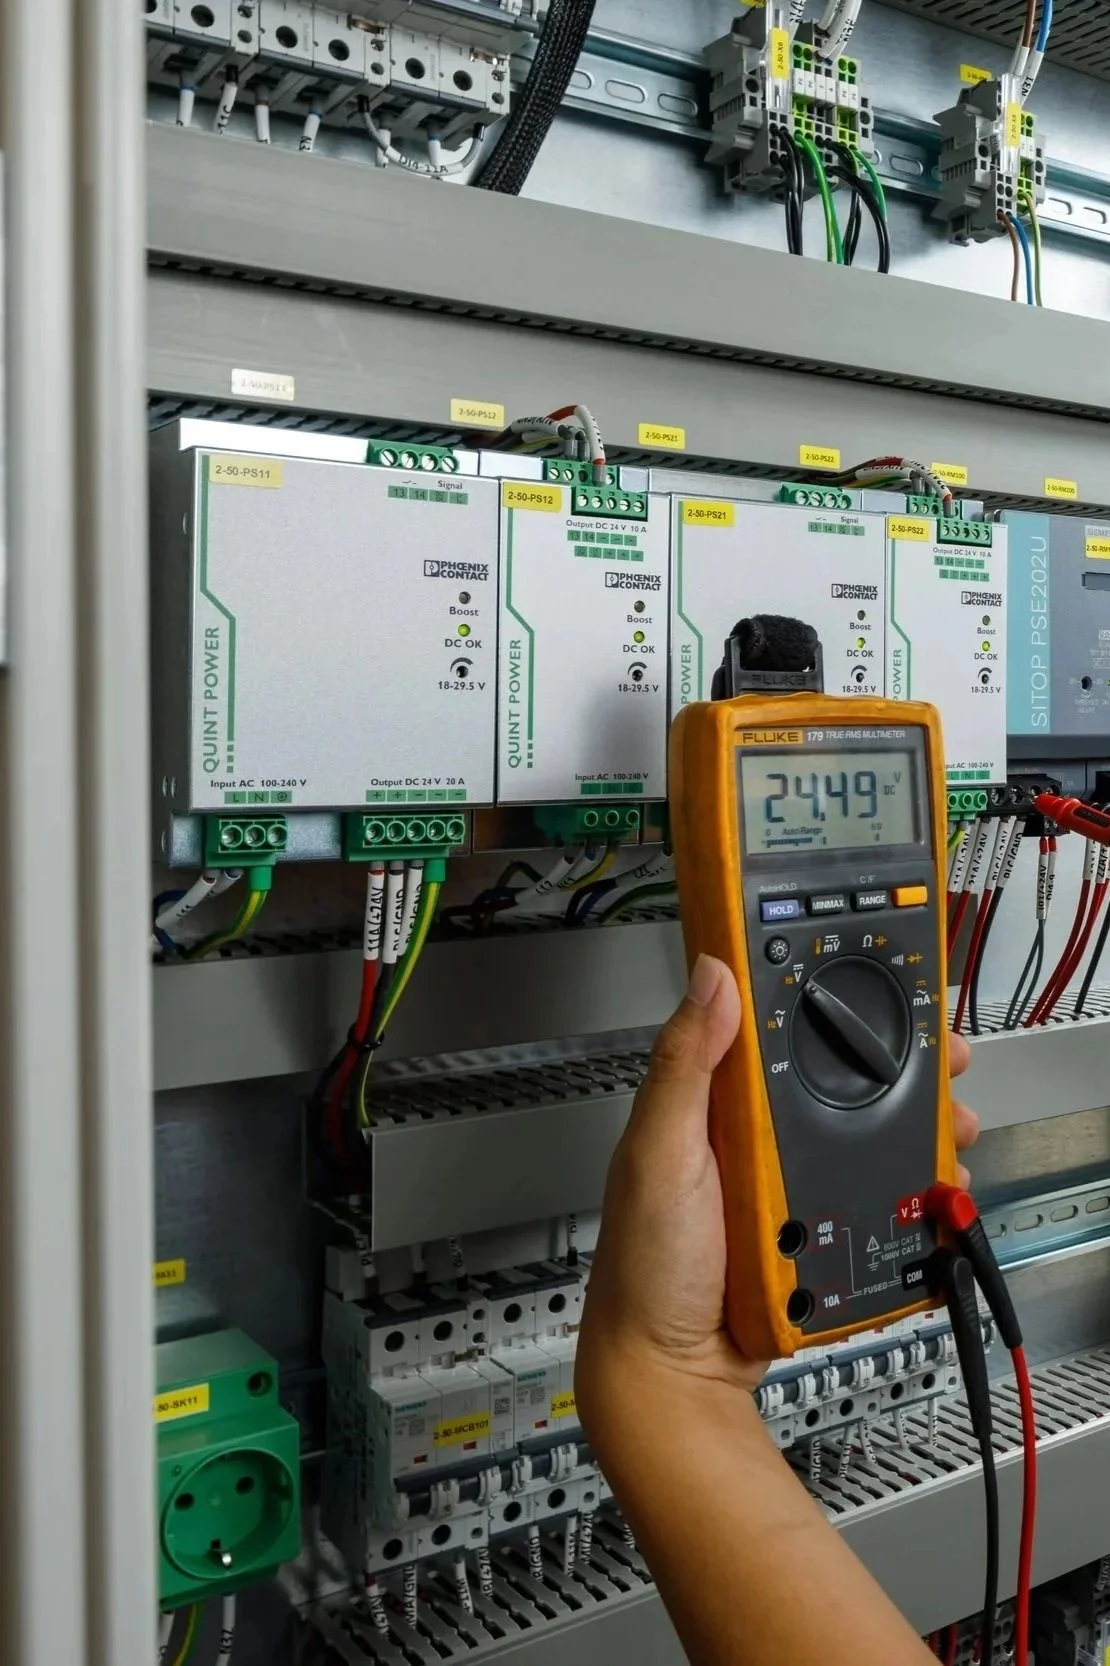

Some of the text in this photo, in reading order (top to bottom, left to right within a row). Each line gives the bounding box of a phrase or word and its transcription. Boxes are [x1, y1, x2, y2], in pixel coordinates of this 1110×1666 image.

[458, 407, 497, 420] 2-50-PS12
[645, 430, 678, 442] 2-50-PS21
[805, 453, 835, 464] 2-50-PS22
[215, 464, 271, 480] 2-50-PS11
[437, 480, 463, 491] Signal
[1047, 484, 1075, 494] 2-50-RM200
[393, 488, 405, 498] 13
[413, 489, 426, 500] 14
[507, 490, 554, 505] 2-50-PS12
[688, 508, 727, 521] 2-50-PS21
[566, 519, 594, 529] Output
[596, 522, 608, 530] DC
[841, 516, 859, 525] Signal
[891, 524, 924, 535] 2-50-PS22
[440, 570, 489, 581] CONTACT
[620, 581, 661, 591] CONTACT
[842, 592, 878, 600] CONTACT
[972, 599, 1002, 607] CONTACT
[449, 606, 479, 617] Boost
[627, 615, 653, 624] Boost
[850, 622, 872, 631] Boost
[1031, 536, 1047, 727] SITOP PSE202U
[444, 638, 482, 649] DC OK
[622, 645, 655, 654] DC OK
[847, 650, 874, 658] DC OK
[974, 652, 998, 661] DC OK
[681, 644, 692, 704] POWER
[439, 681, 486, 691] 18-29.5 V
[751, 674, 807, 687] FLUKE
[618, 684, 659, 693] 18-29.5 V
[842, 685, 877, 694] 18-29.5 V
[203, 626, 220, 773] QUINT POWER
[508, 639, 521, 769] QUINT POWER
[742, 731, 799, 744] FLUKE
[807, 732, 824, 742] 179
[826, 731, 844, 740] TRUE
[862, 730, 906, 739] MULTIMETER
[944, 762, 956, 770] put
[370, 778, 465, 789] Output DC 24 V 20 A
[575, 774, 594, 782] Input
[894, 772, 901, 784] V
[210, 779, 307, 790] Input AC 100-240 V
[884, 785, 896, 796] DC
[765, 770, 878, 824] 24.49
[860, 895, 886, 905] RANGE
[769, 906, 794, 916] HOLD
[824, 940, 840, 953] mV
[785, 971, 802, 985] Hz V
[913, 994, 931, 1007] mA
[768, 1016, 784, 1029] Hz V
[920, 1037, 928, 1048] A
[771, 1060, 790, 1074] OFF
[901, 1208, 908, 1218] V
[817, 1221, 834, 1235] 400
[818, 1234, 834, 1246] mA
[901, 1236, 914, 1246] CAT
[902, 1246, 915, 1256] CAT
[906, 1270, 923, 1284] COM
[864, 1282, 888, 1295] FUSED
[824, 1294, 841, 1309] 10A
[155, 1396, 198, 1413] -50-SK11
[434, 1420, 489, 1441] 2-50-MCB101
